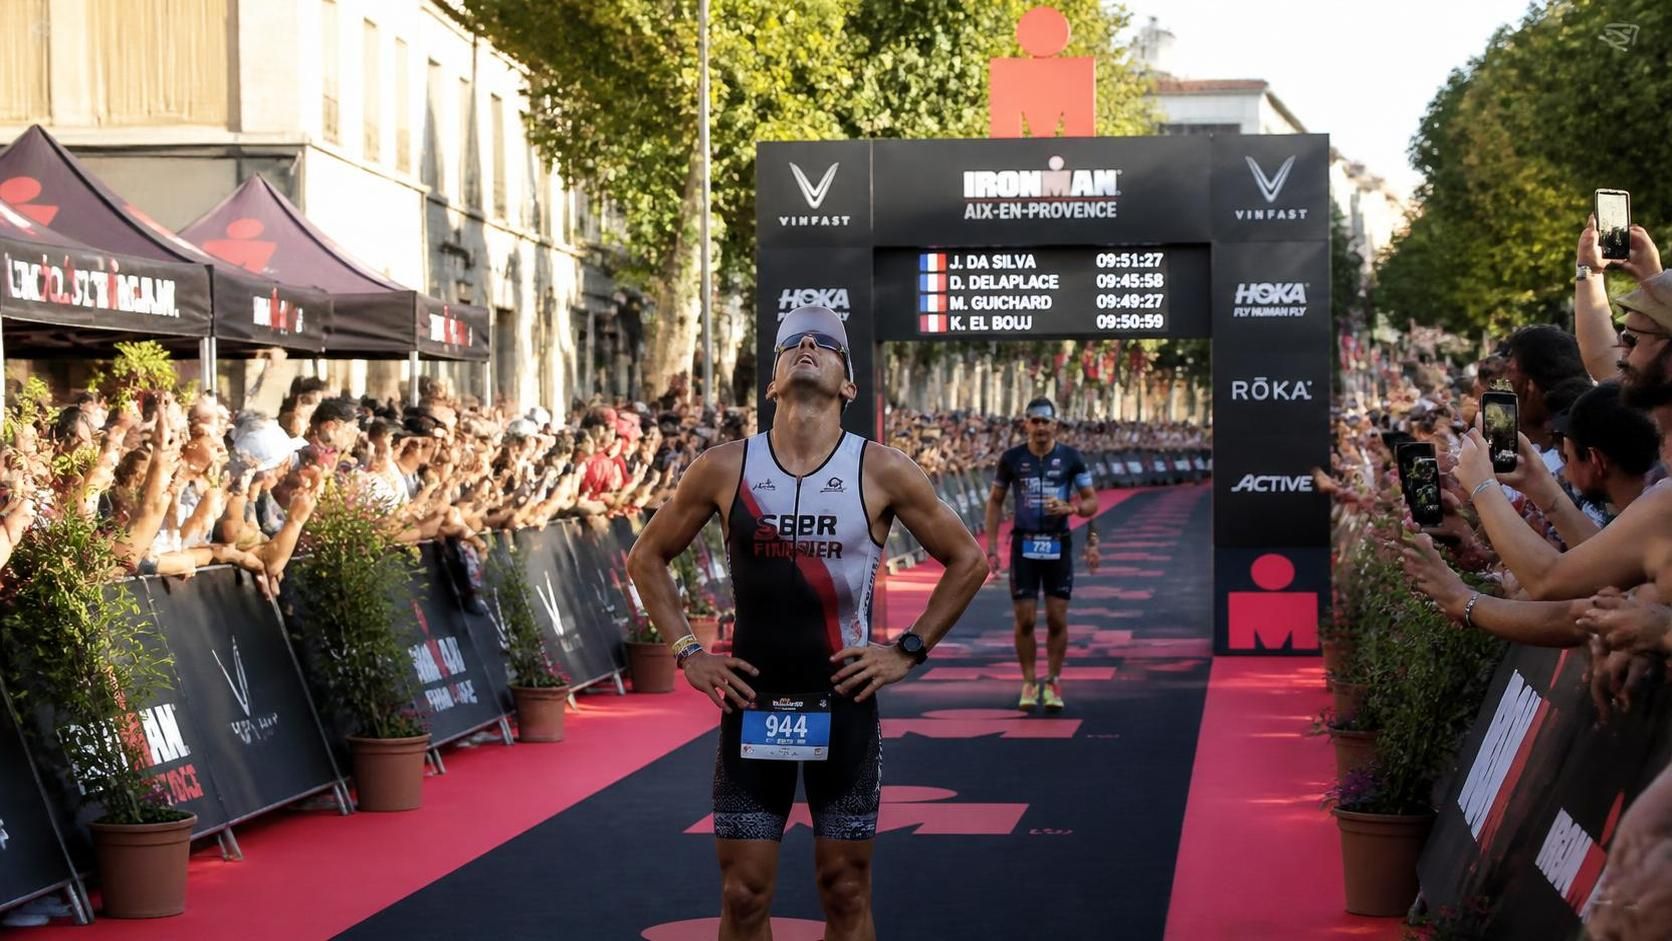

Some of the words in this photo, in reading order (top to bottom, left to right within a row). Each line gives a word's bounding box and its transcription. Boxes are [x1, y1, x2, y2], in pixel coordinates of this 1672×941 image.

[963, 156, 1118, 198] IRONMAN
[964, 202, 1117, 219] AIX-EN-PROVENCE
[1235, 209, 1308, 220] VINFAST
[779, 216, 850, 226] VINFAST
[949, 255, 963, 269] J.
[967, 255, 989, 269] DA
[992, 254, 1037, 269] SILVA
[1096, 253, 1164, 268] 09:51:27
[950, 276, 965, 290] D.
[969, 275, 1060, 290] DELAPLACE
[1096, 274, 1164, 288] 09:45:58
[778, 289, 850, 309] HOKA
[1234, 282, 1308, 304] HOKA
[950, 296, 968, 310] M.
[971, 295, 1053, 310] GUICHARD
[1096, 294, 1164, 309] 09:49:27
[1234, 307, 1251, 318] FLY
[1251, 307, 1289, 318] HUMAN
[1289, 307, 1307, 318] FLY
[950, 316, 966, 330] K.
[969, 316, 989, 330] EL
[1096, 314, 1164, 329] 09:50:59
[1231, 473, 1313, 492] ACTIVE
[765, 715, 808, 737] 944
